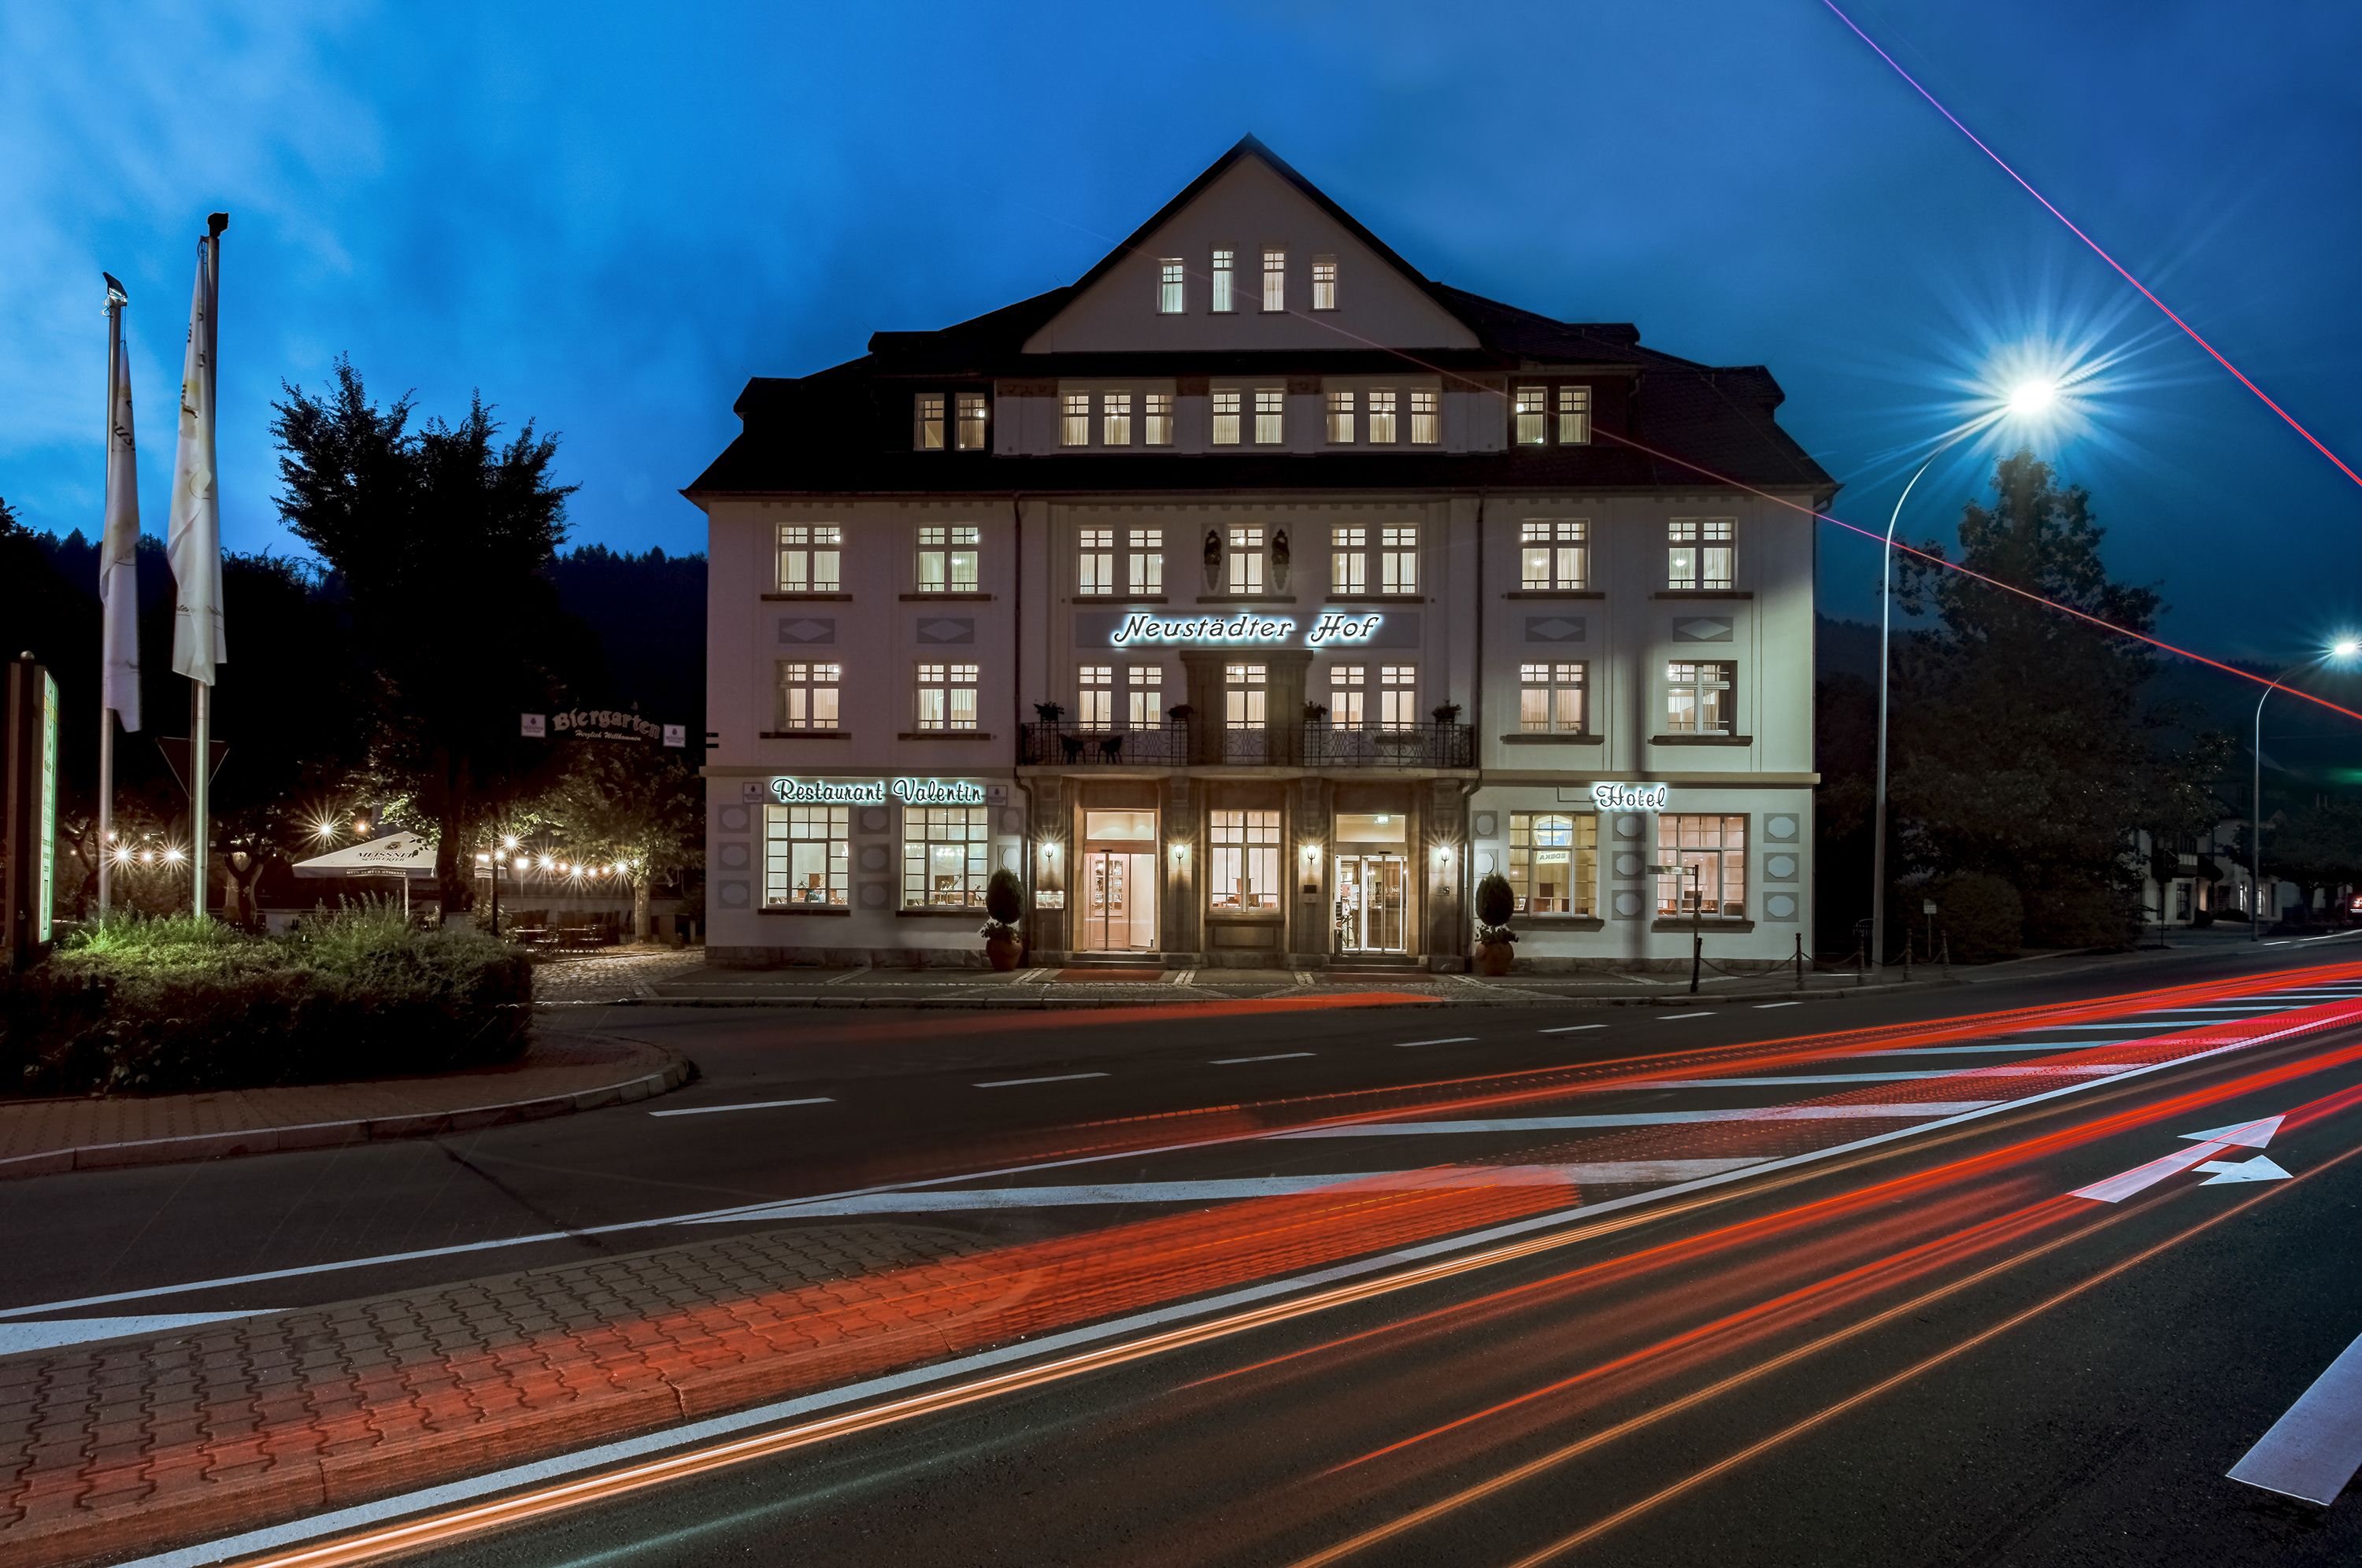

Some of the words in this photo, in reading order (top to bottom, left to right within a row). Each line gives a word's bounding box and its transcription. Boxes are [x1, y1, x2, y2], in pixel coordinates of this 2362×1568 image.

[1113, 616, 1293, 643] Neustädter
[1311, 616, 1380, 643] Hof
[551, 708, 661, 739] Biergarten
[575, 730, 602, 740] Herzlich
[604, 731, 642, 741] Willkommen
[772, 778, 883, 801] Restaurant
[893, 779, 982, 802] Valentin
[1596, 785, 1665, 808] Hotel
